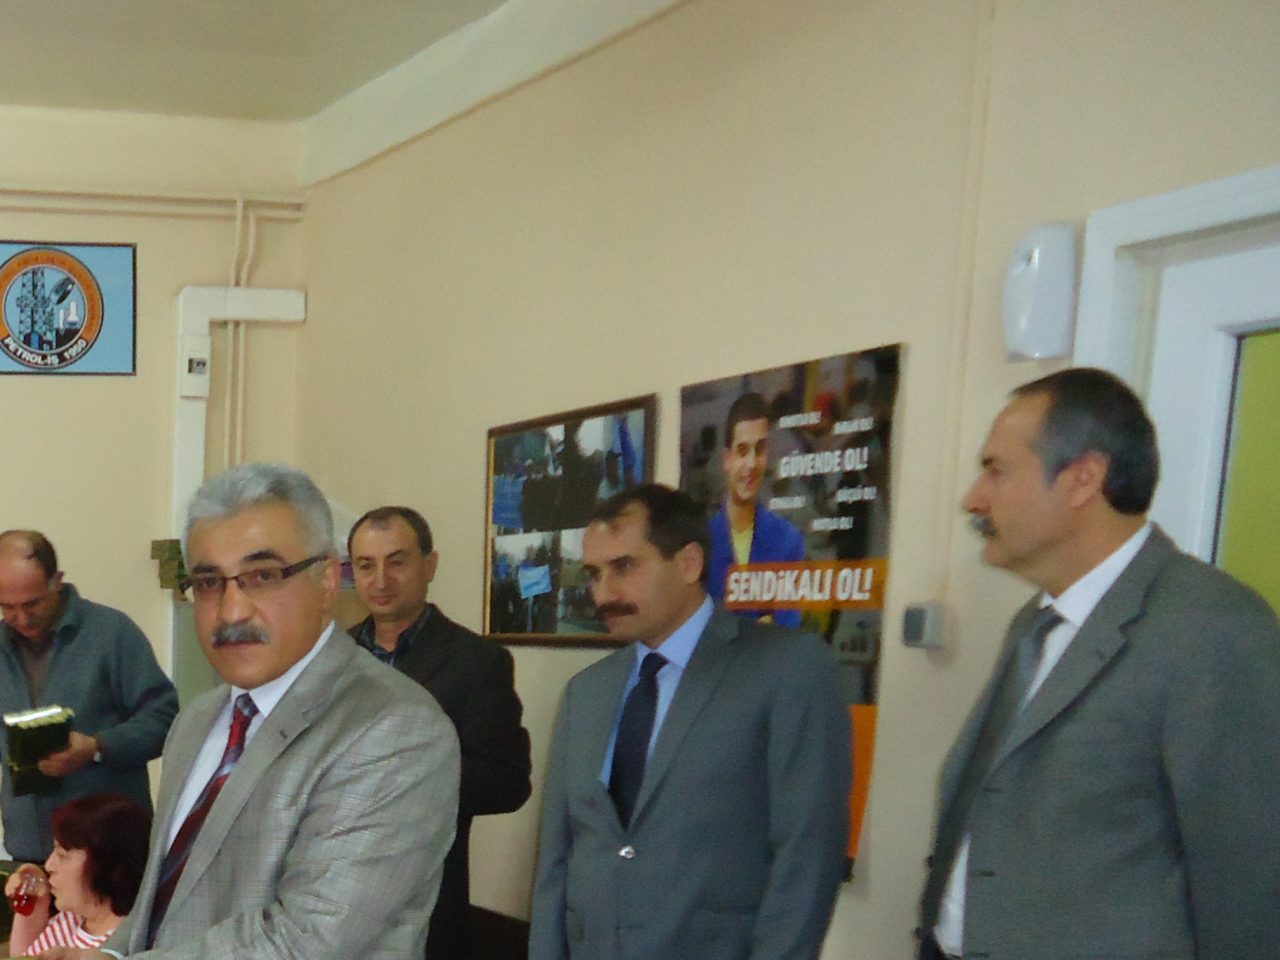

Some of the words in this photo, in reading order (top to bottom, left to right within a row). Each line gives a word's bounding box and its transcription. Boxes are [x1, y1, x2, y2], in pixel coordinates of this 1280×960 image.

[779, 450, 842, 478] GÜVENDE
[843, 446, 869, 471] OL!
[836, 567, 873, 601] OL!
